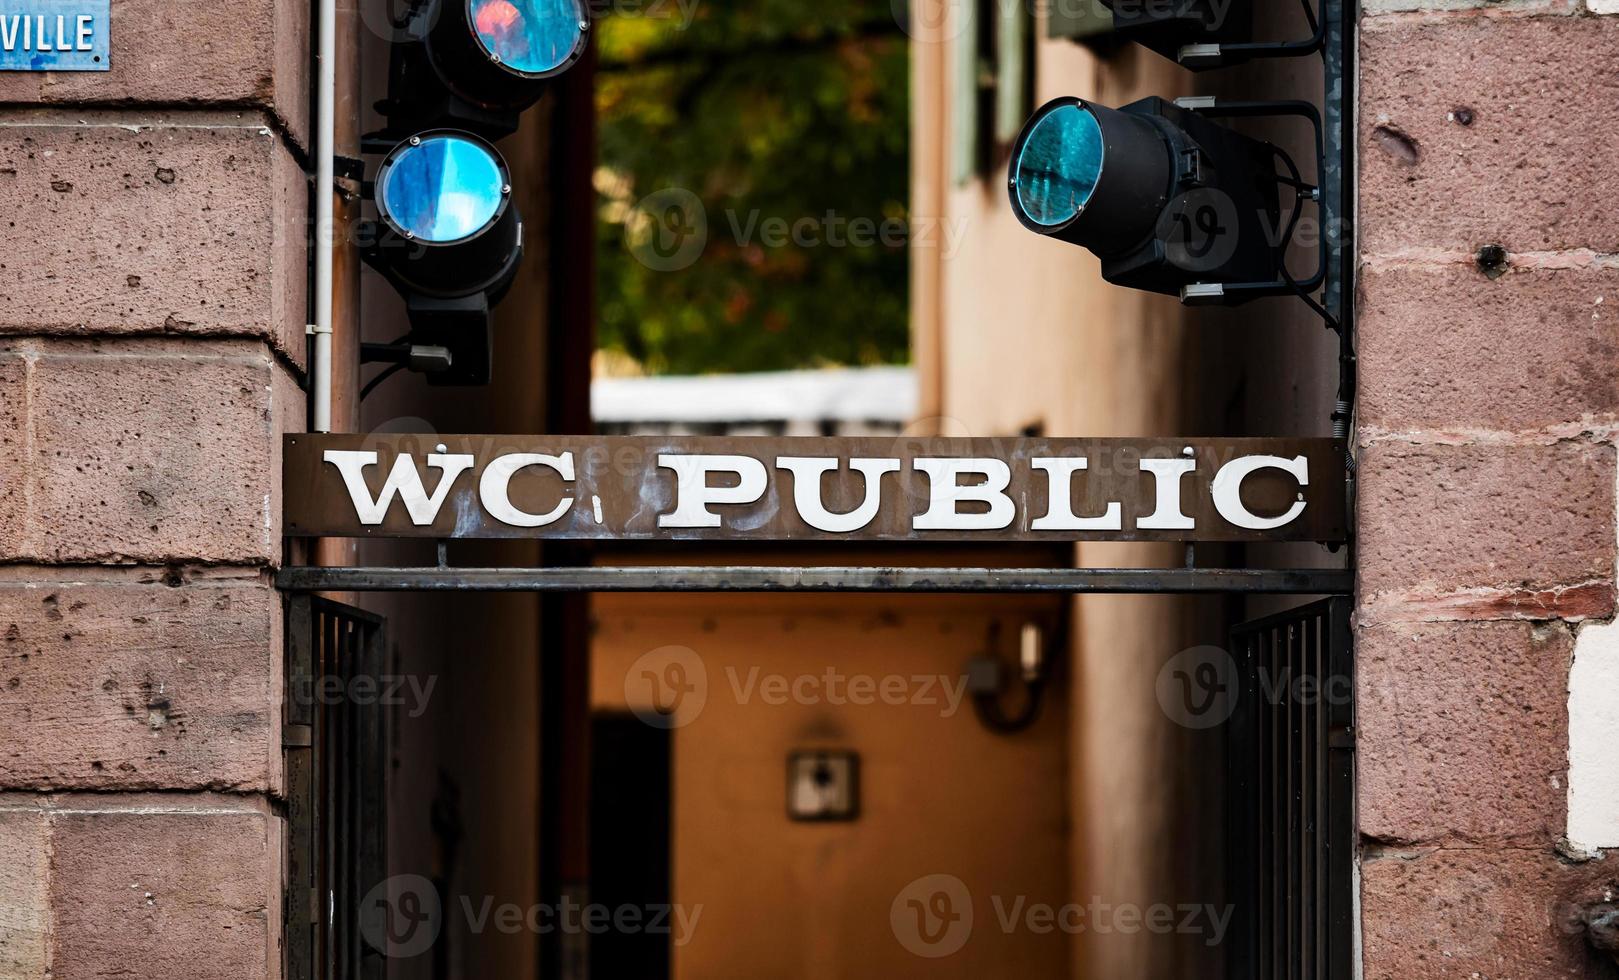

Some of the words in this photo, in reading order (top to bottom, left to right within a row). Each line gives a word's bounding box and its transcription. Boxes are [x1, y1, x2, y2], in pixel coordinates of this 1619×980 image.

[0, 15, 93, 51] VILLE
[323, 450, 575, 527] WC
[658, 454, 1309, 533] PUBLIC
